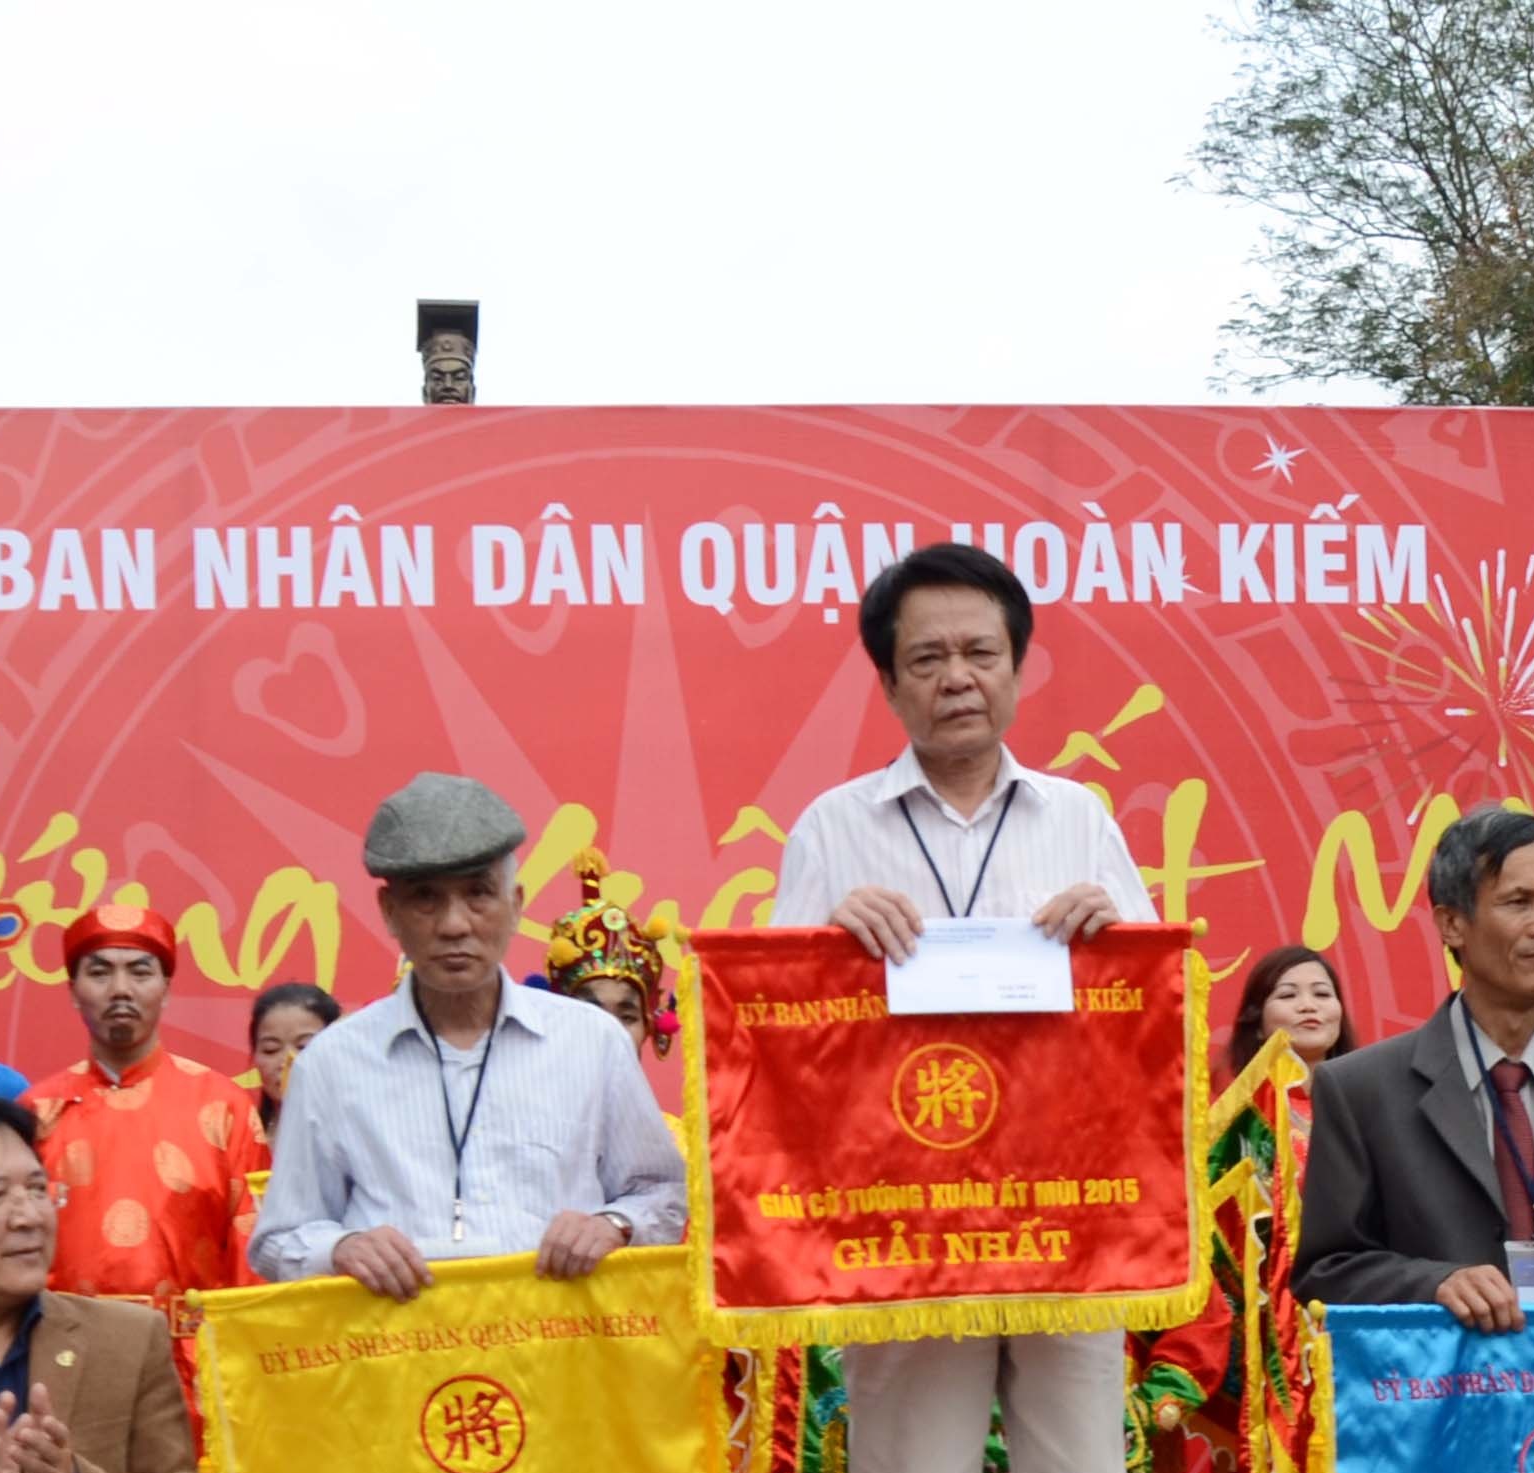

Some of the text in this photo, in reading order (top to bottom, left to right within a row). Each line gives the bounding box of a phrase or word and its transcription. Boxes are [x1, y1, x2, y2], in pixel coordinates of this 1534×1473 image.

[193, 505, 435, 609] NHÂN
[471, 503, 645, 605] DÂN
[680, 502, 915, 624] QUẬN
[1219, 494, 1427, 604] KIẾM
[1085, 979, 1144, 1012] KIẾM
[772, 1001, 821, 1026] BAN
[1083, 1178, 1140, 1205] 2015
[833, 1216, 1071, 1271] GIẢI NHẤT
[296, 1341, 341, 1369] BAN
[1408, 1376, 1453, 1400] BAN
[443, 1391, 513, 1462] 將
